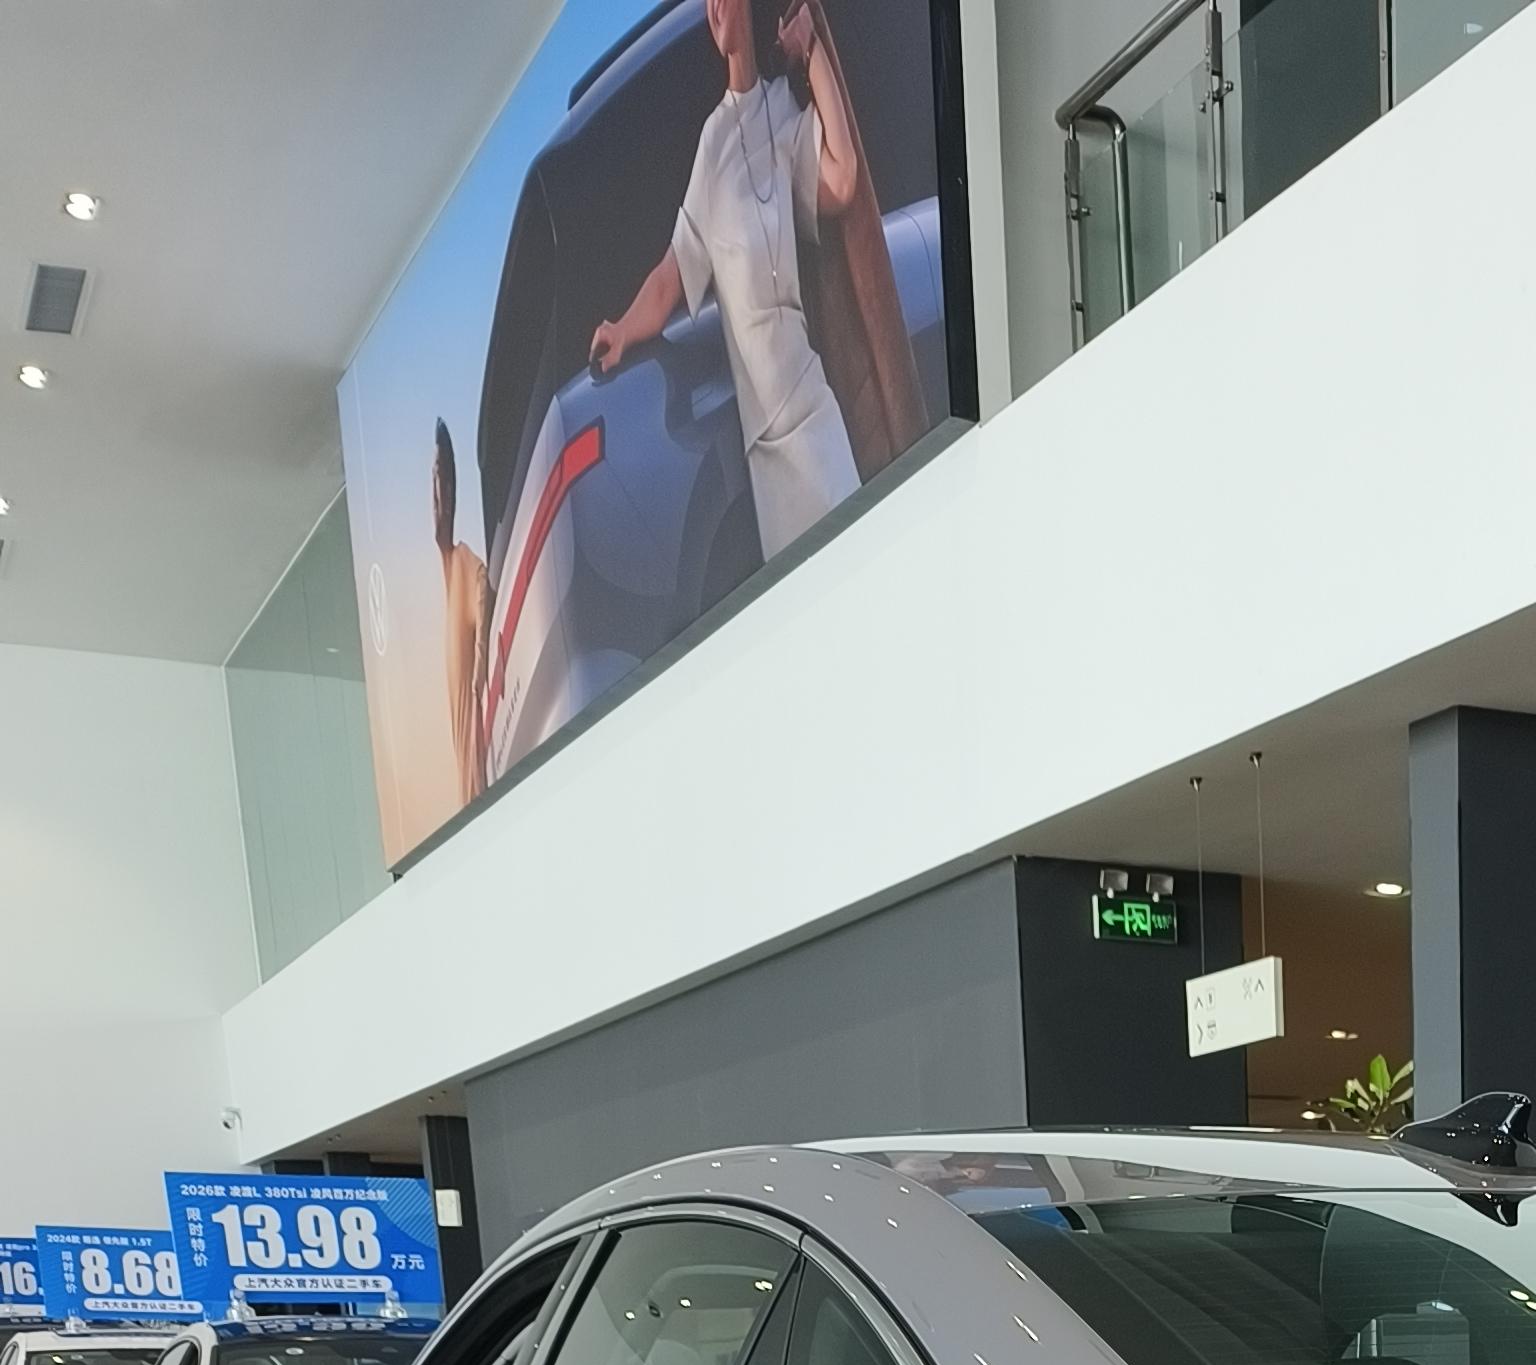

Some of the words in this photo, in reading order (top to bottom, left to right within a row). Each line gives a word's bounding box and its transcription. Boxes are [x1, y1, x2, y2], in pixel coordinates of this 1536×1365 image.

[179, 1183, 227, 1198] 2026款
[211, 1203, 383, 1270] 13.98
[390, 1252, 426, 1271] 万元
[80, 1248, 182, 1297] 8.68
[243, 1276, 384, 1290] 上汽大众官方认证二手车
